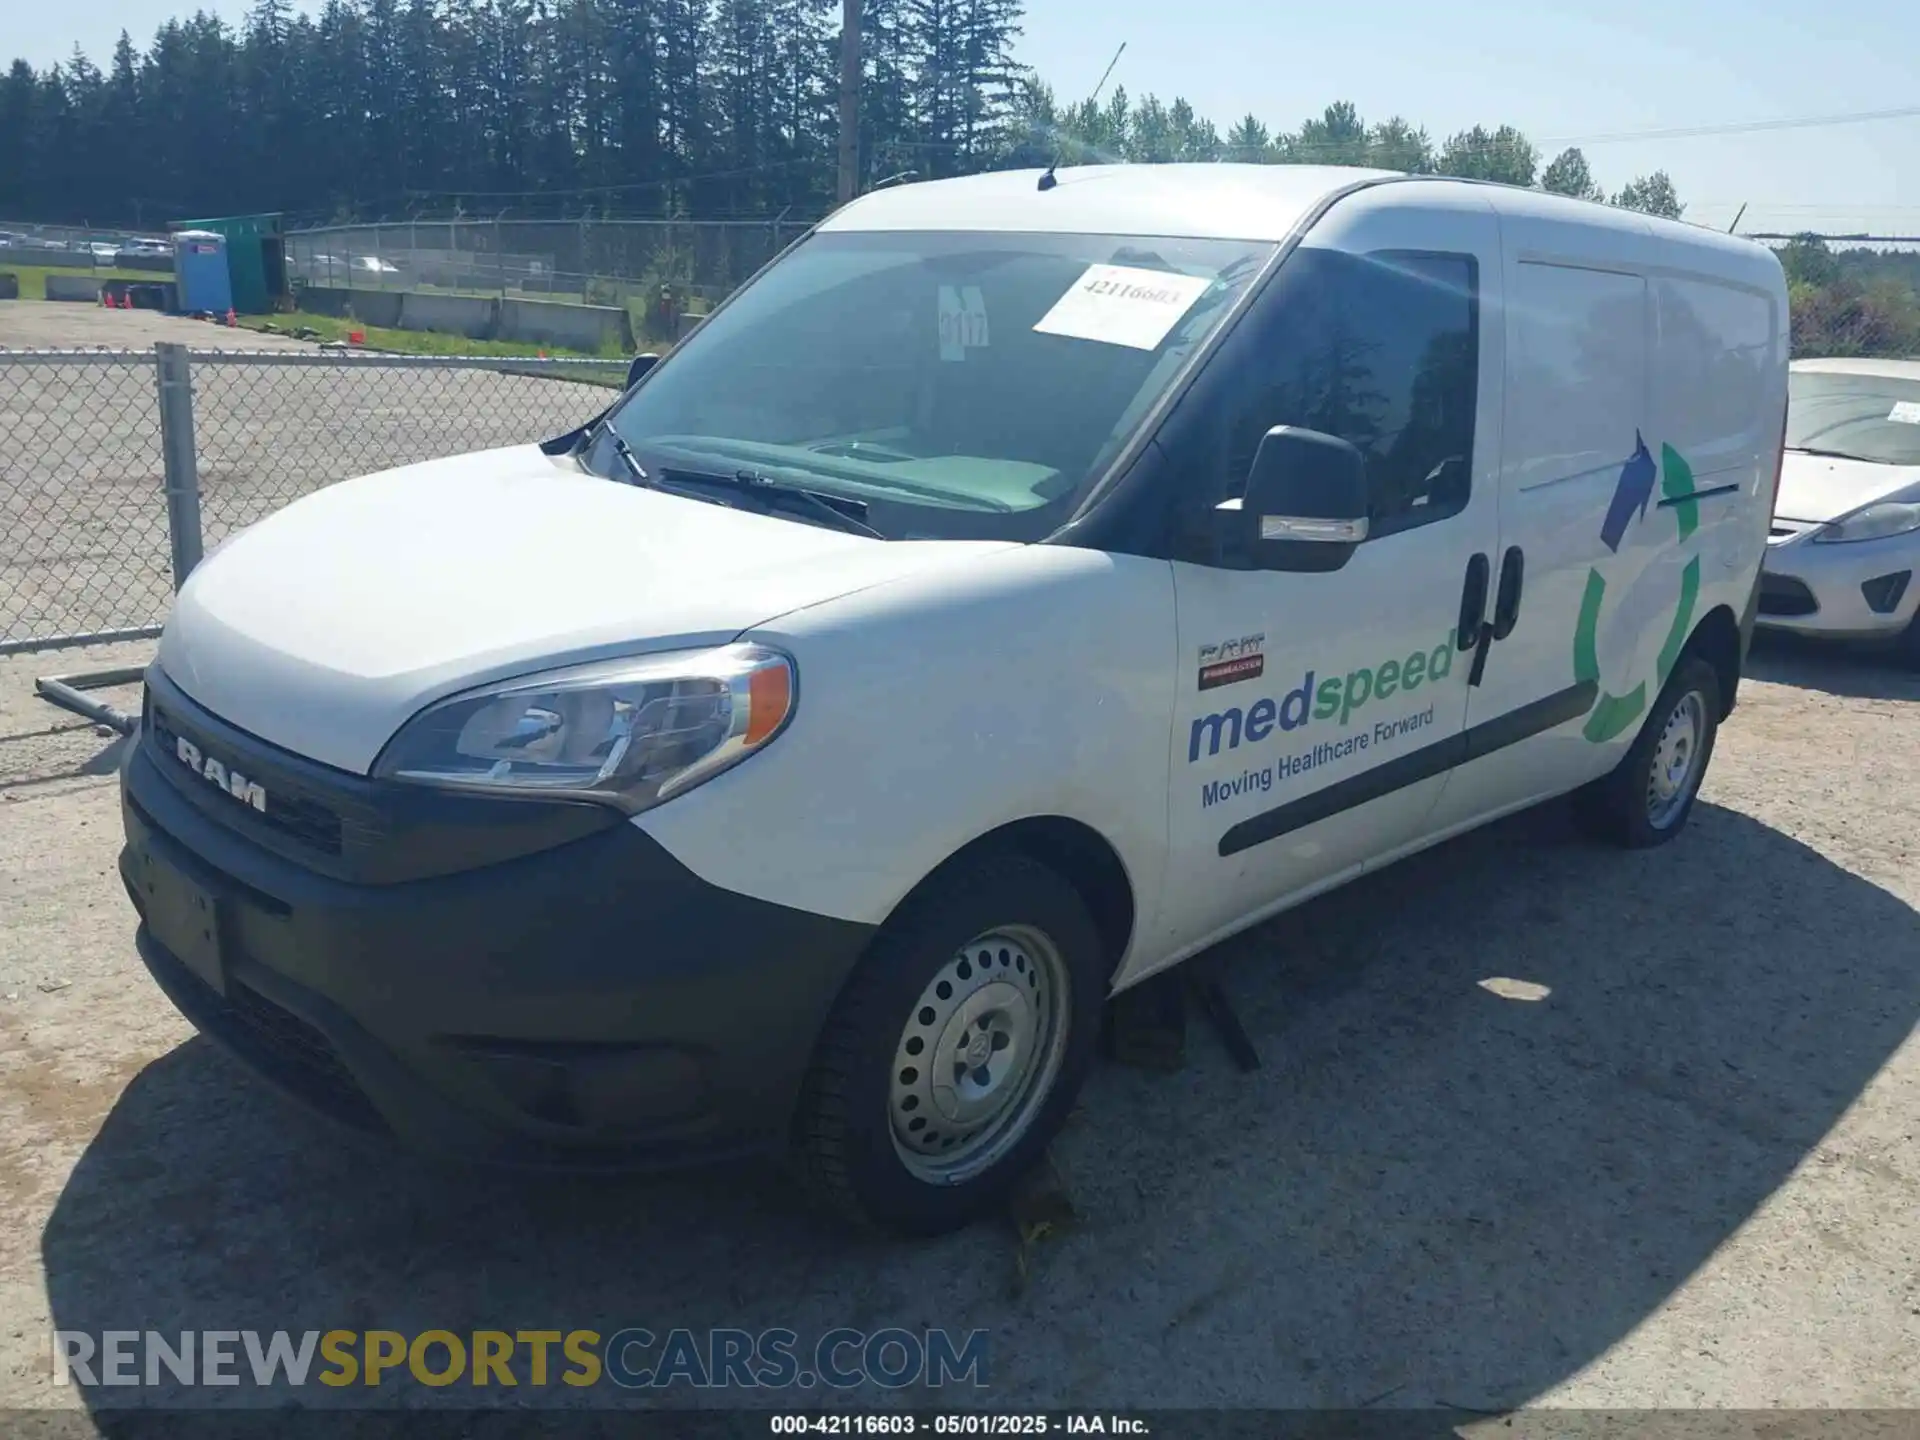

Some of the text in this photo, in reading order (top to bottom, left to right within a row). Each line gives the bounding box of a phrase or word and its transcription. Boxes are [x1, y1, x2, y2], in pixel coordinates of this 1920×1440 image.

[1188, 628, 1456, 763] medspeed
[177, 736, 266, 812] RAM
[1202, 704, 1434, 808] Moving Healthcare Forward
